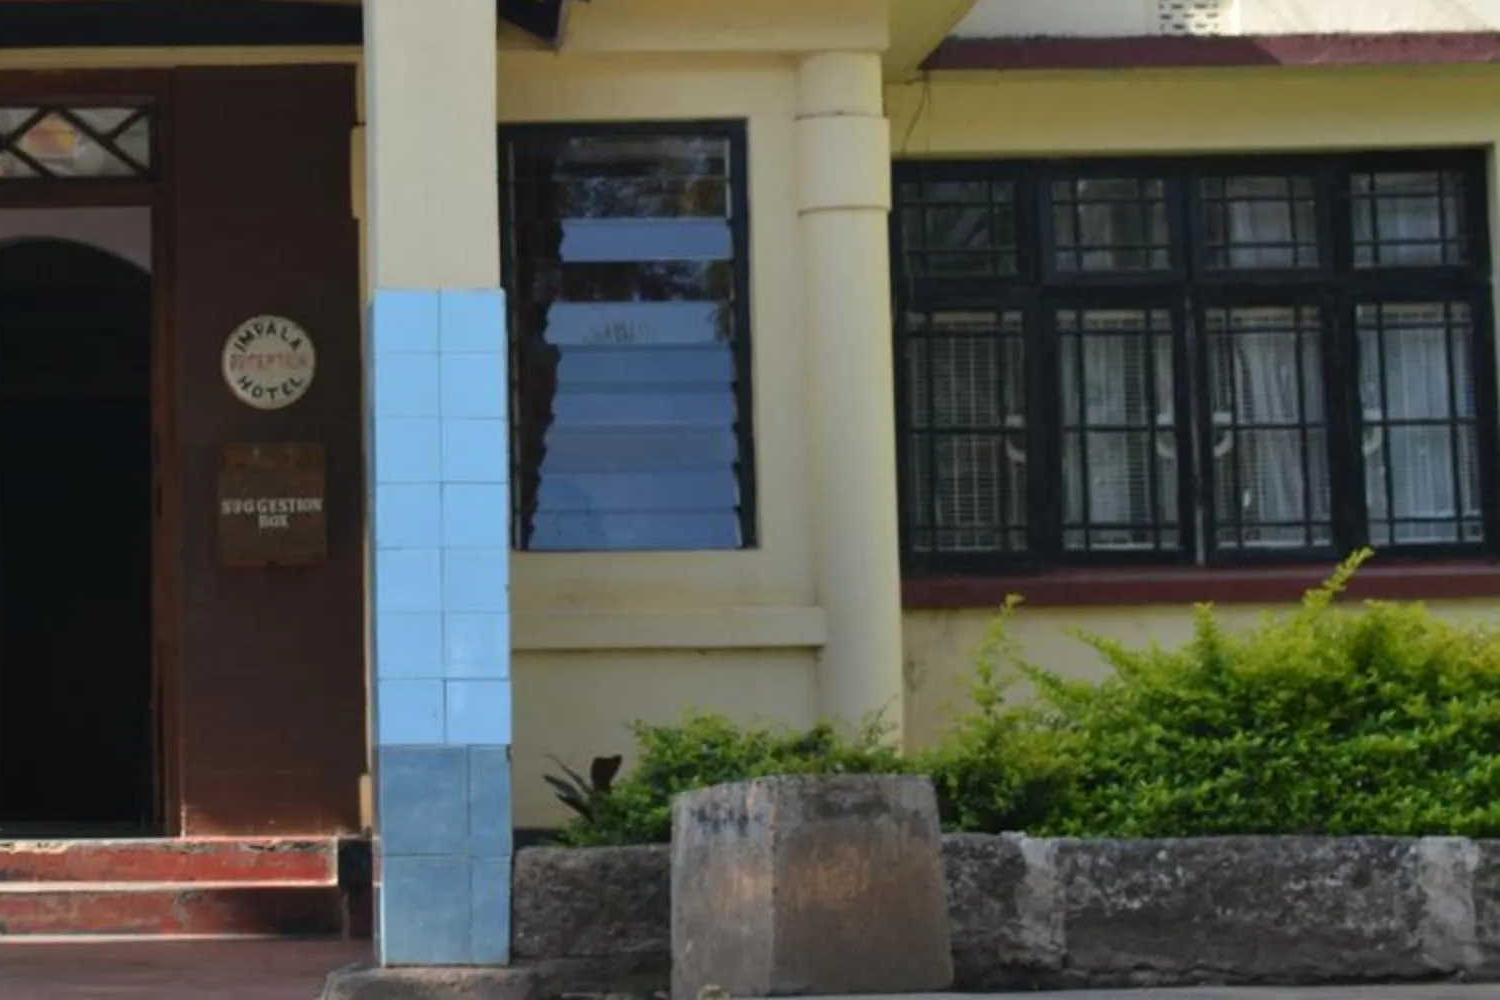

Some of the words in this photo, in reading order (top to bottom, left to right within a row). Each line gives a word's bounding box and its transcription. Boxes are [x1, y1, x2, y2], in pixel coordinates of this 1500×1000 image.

[233, 320, 303, 353] IMPALA
[237, 375, 305, 401] HOTEL
[220, 498, 323, 515] SUGGESTION
